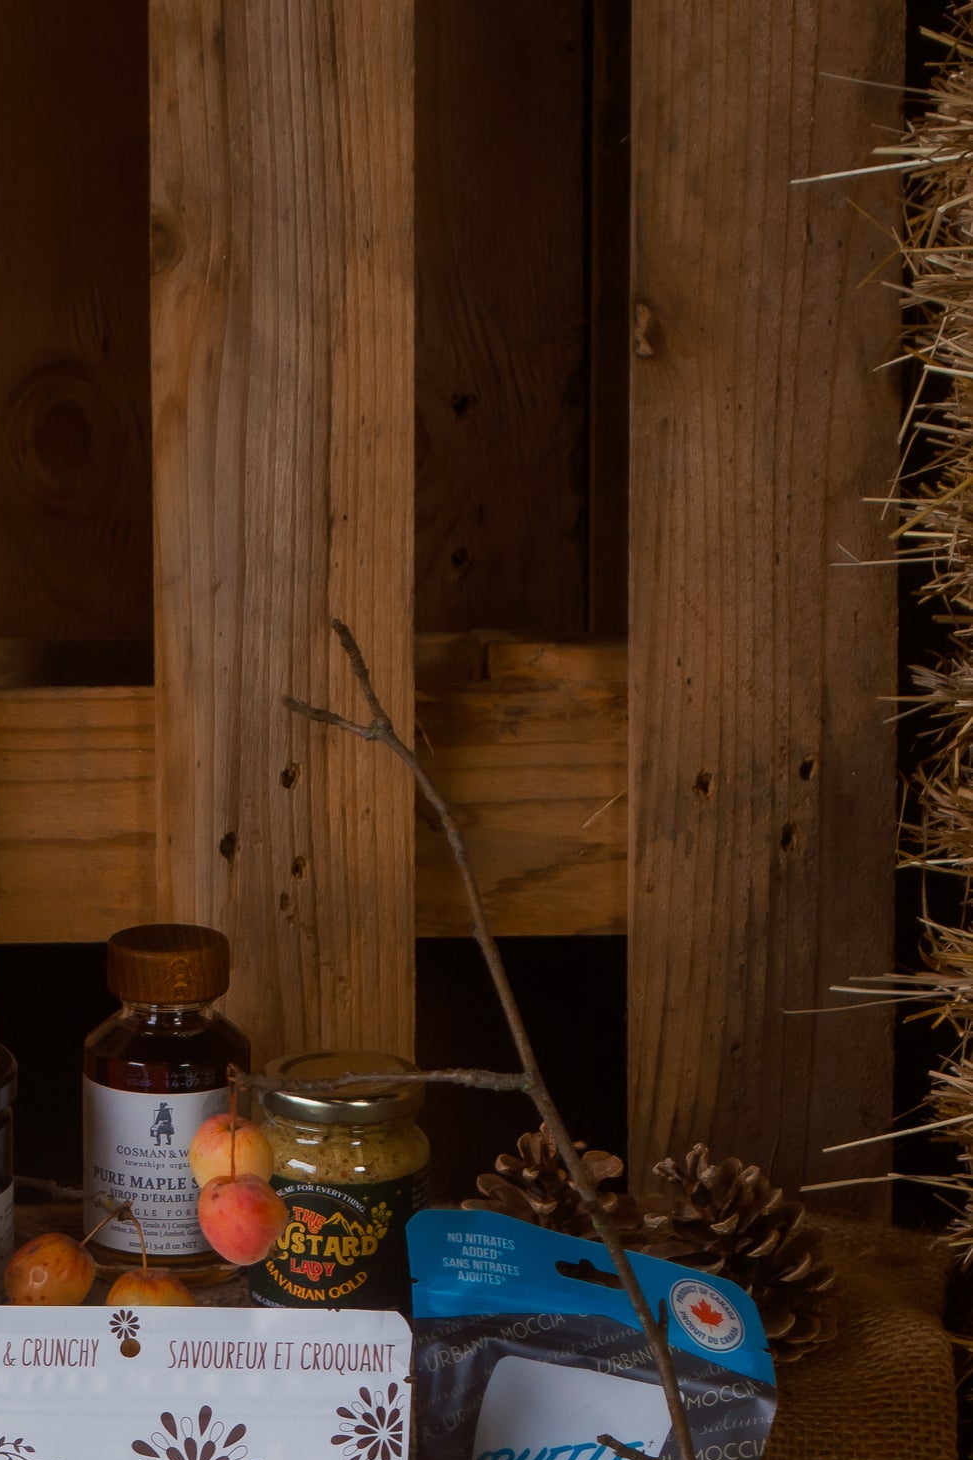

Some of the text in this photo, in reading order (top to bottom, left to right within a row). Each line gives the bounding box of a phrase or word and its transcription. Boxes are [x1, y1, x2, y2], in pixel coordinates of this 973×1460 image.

[116, 1145, 167, 1158] COSMAN
[169, 1150, 177, 1158] &
[125, 1159, 166, 1170] townships
[93, 1165, 125, 1186] PURE
[129, 1175, 186, 1190] MAPLE
[109, 1188, 195, 1203] SIROP D'ÉRABLE
[297, 1184, 367, 1213] FOR EVERYTHING
[292, 1206, 327, 1235] THE
[276, 1222, 379, 1267] USTARD
[447, 1232, 515, 1250] NO NITRATES
[265, 1261, 326, 1301] BAVARIAN
[328, 1271, 368, 1299] GOLD
[289, 1258, 336, 1282] LADY
[442, 1257, 520, 1276] SANS NITRATES
[679, 1310, 719, 1345] PRODUIT DU
[2, 1341, 17, 1367] &
[22, 1338, 100, 1368] CRUNCHY
[425, 1313, 567, 1373] URBANI MOCCIA
[167, 1340, 396, 1376] SAVOUREUX ET CROQUANT
[686, 1381, 762, 1411] MOCCIA
